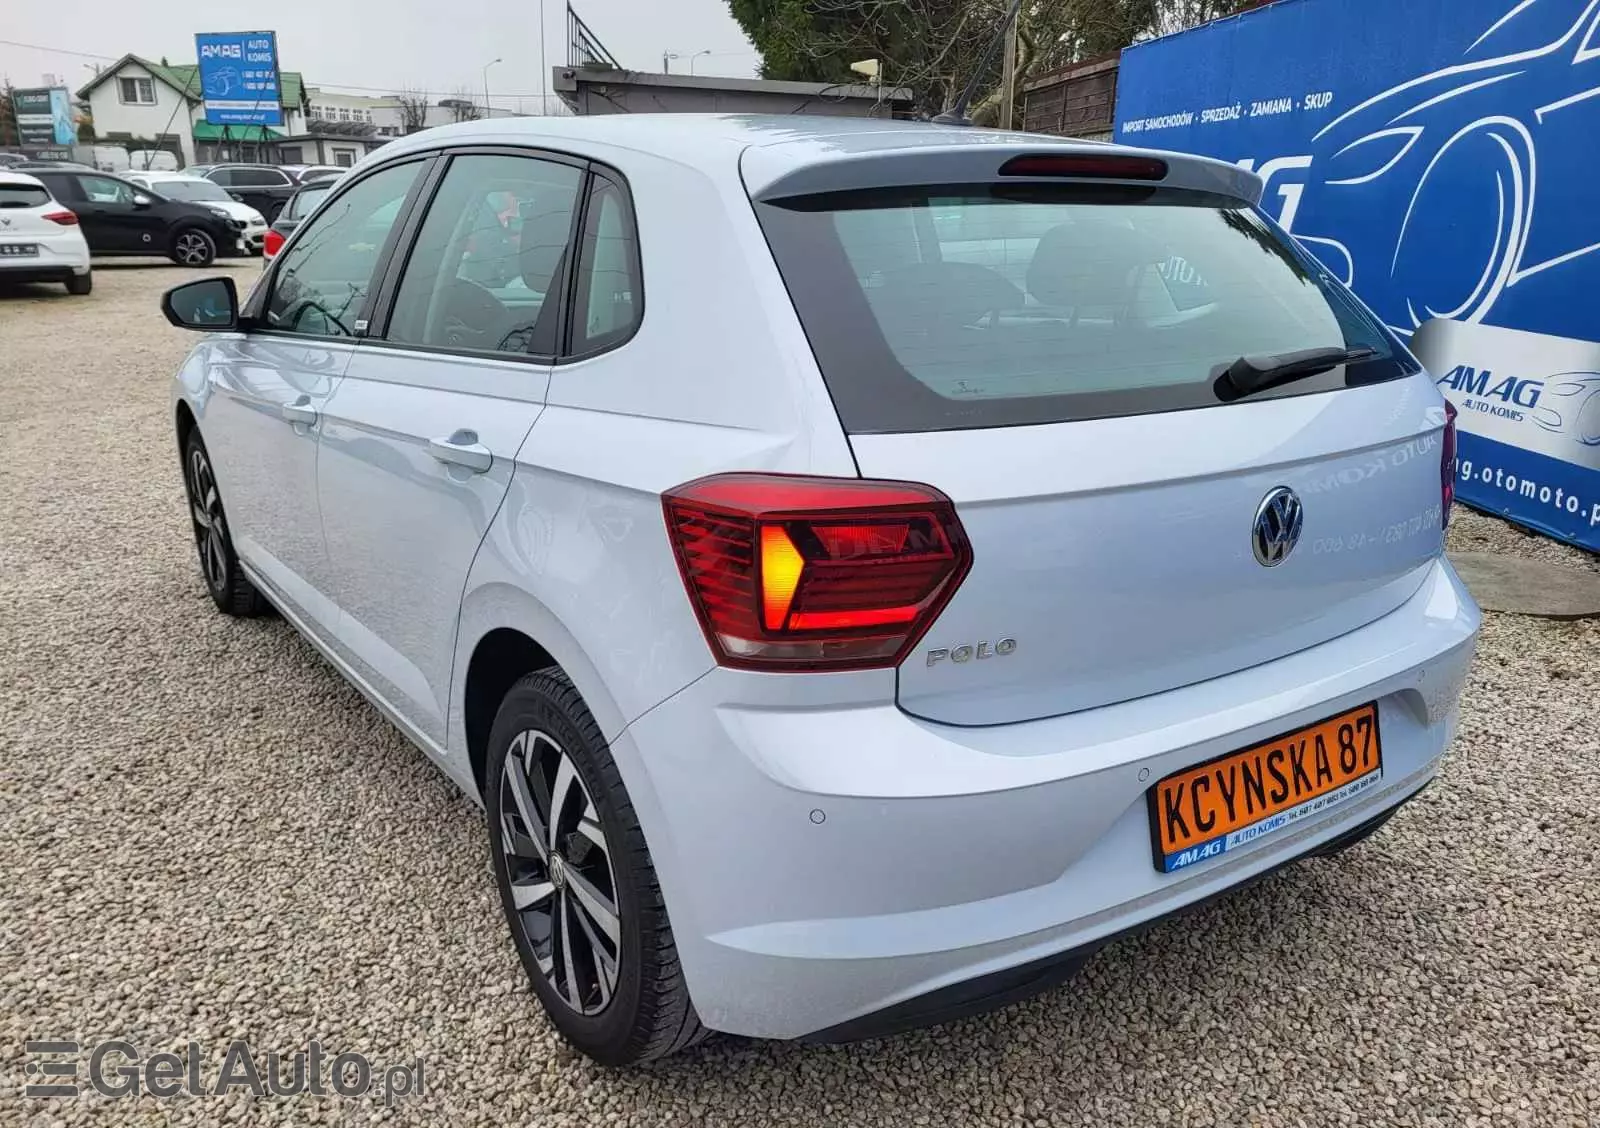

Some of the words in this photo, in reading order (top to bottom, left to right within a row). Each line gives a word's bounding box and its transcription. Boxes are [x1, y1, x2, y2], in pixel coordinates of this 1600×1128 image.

[201, 44, 241, 58] AMAG
[247, 52, 272, 62] KOMIS
[248, 40, 269, 49] AUTO
[1122, 116, 1144, 133] IMPORT
[1145, 111, 1194, 131] SAMOCHODÓW
[1201, 101, 1242, 123] SPRZEDAŻ
[1250, 97, 1292, 117] ZAMIANA
[1304, 91, 1333, 110] SKUP
[1436, 364, 1544, 409] AMAG
[1462, 399, 1489, 413] AUTO
[1490, 405, 1525, 422] KOMIS
[1455, 457, 1600, 526] g.otomoto.p
[926, 637, 1017, 668] POLO
[1164, 733, 1333, 843] KCYNSKA
[1337, 714, 1373, 776] 87
[1171, 840, 1221, 869] AMAG
[1231, 827, 1257, 846] AUTO
[1258, 815, 1287, 834] KOMIS
